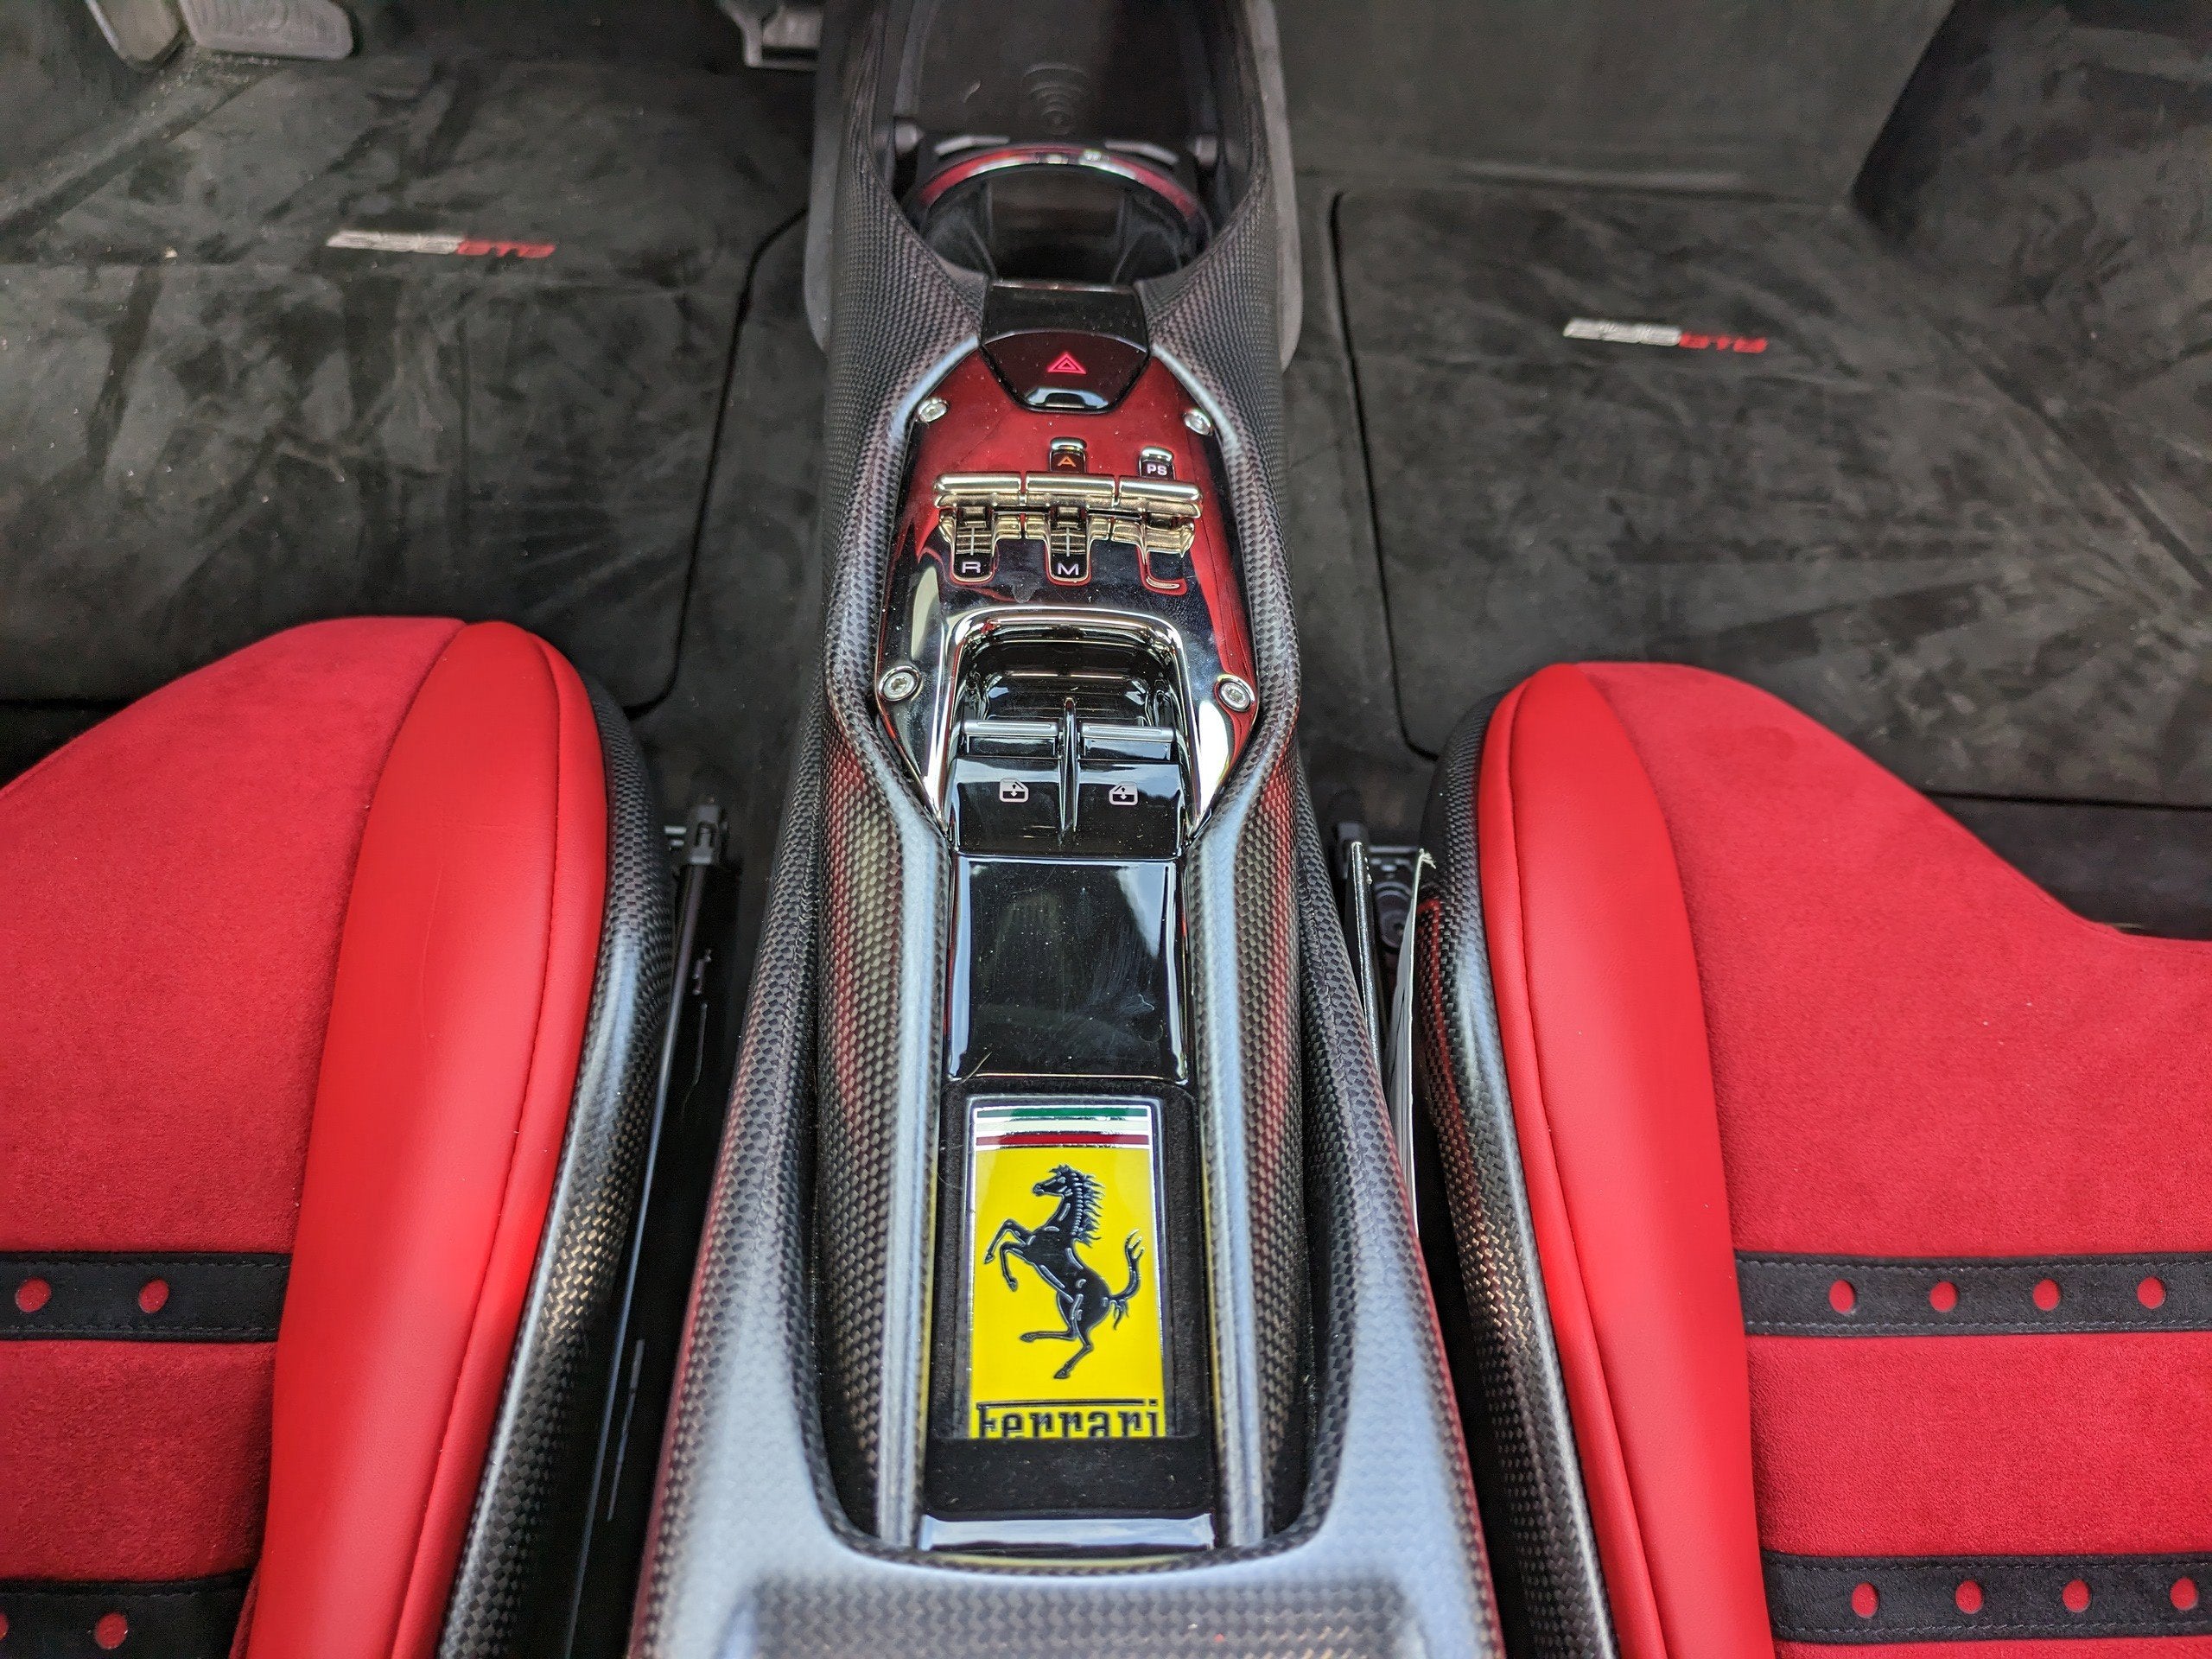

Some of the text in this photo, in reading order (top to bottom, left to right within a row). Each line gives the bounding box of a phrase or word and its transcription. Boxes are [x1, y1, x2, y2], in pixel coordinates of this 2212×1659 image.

[1058, 456, 1077, 467] A
[961, 562, 982, 574] R
[1057, 563, 1079, 575] M
[976, 1399, 1158, 1438] Ferrari
